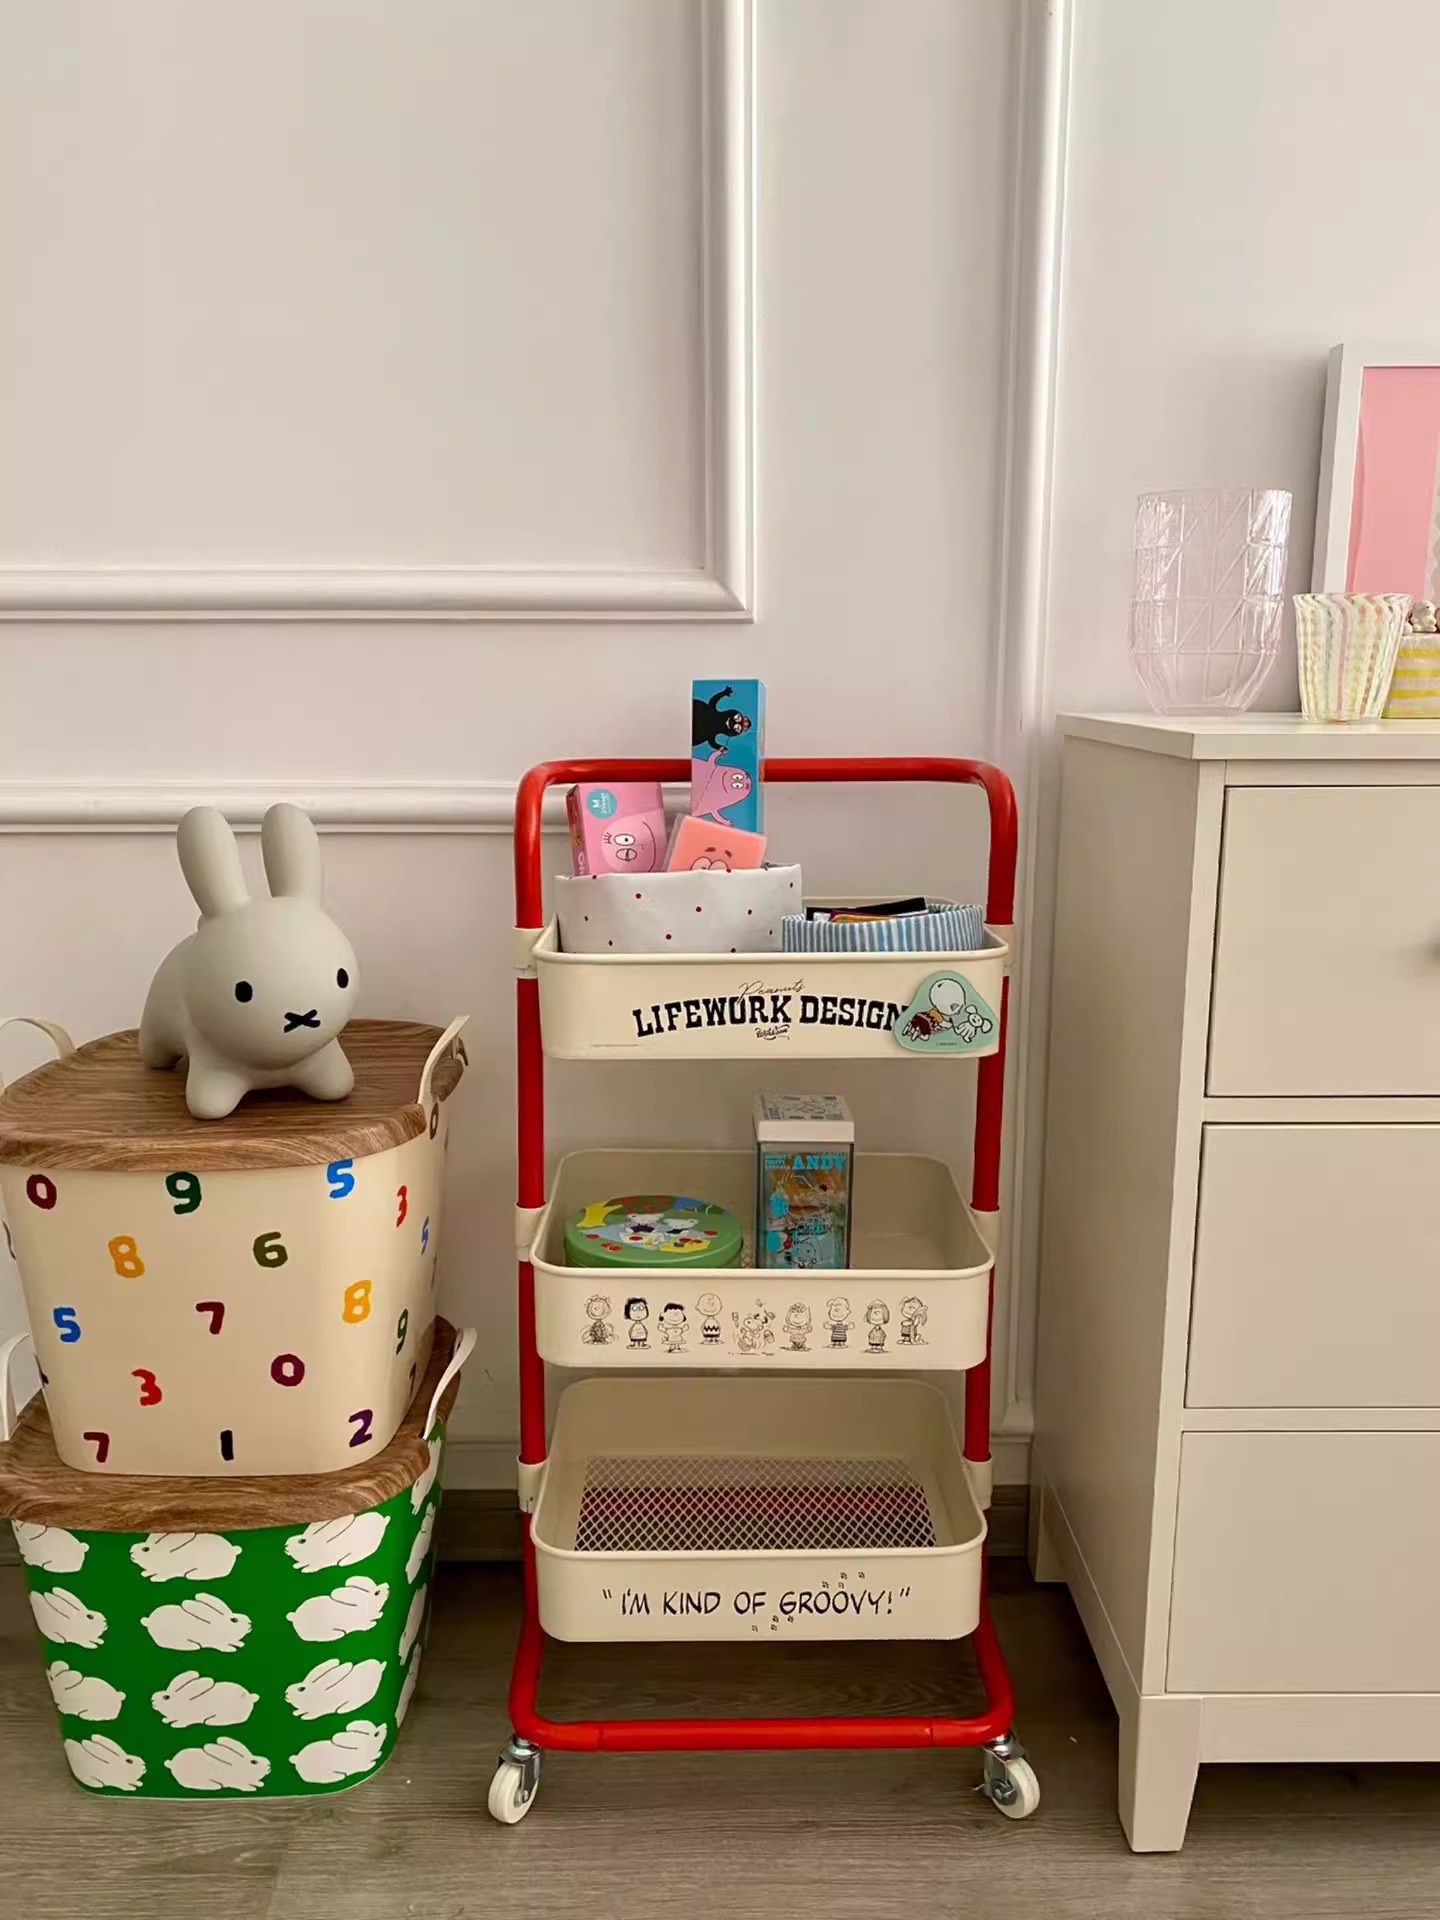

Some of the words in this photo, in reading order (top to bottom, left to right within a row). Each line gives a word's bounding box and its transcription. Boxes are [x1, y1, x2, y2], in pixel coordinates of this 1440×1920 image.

[632, 994, 792, 1037] LIFEWORK
[165, 1171, 202, 1214] 9
[326, 1159, 355, 1198] 5
[108, 1235, 145, 1278] 8
[253, 1231, 288, 1268] 6
[196, 1302, 225, 1335] 7
[342, 1280, 371, 1323] 8
[53, 1307, 81, 1343] 5
[132, 1369, 162, 1406] 3
[84, 1432, 110, 1463] 7
[348, 1409, 373, 1448] 2
[663, 1590, 720, 1616] KIND
[733, 1591, 767, 1615] OF
